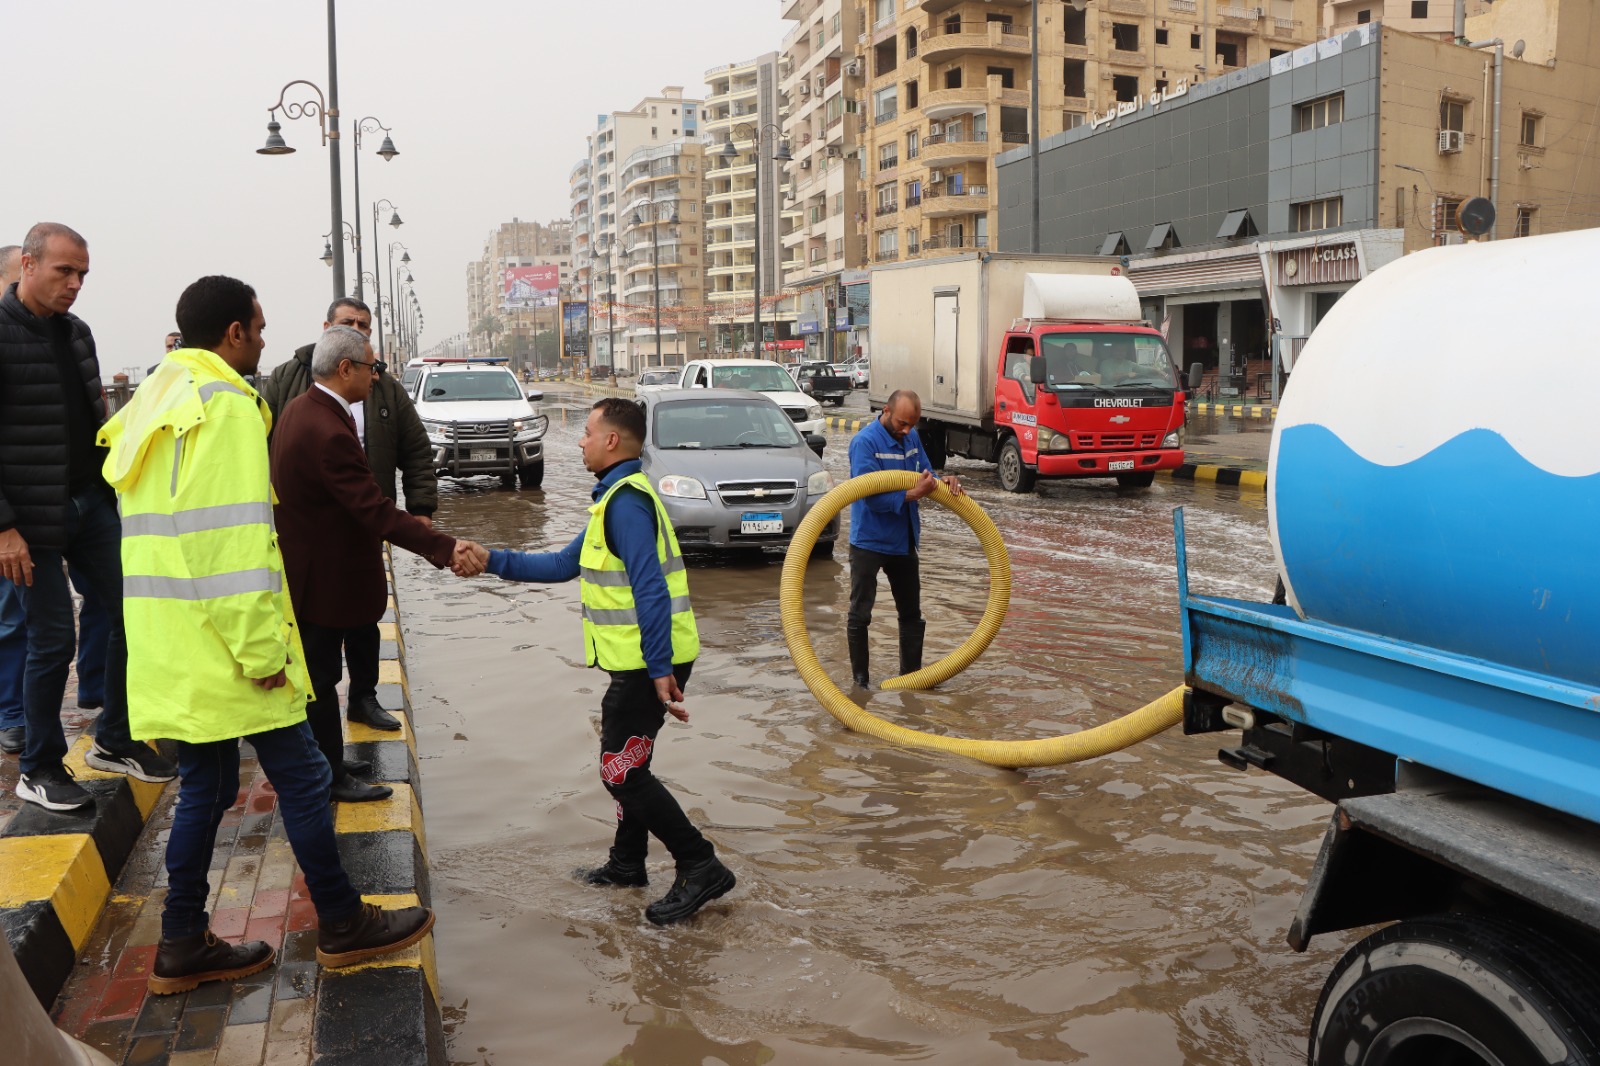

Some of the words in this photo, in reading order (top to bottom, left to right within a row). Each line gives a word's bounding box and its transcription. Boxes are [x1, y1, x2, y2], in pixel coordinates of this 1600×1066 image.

[1150, 78, 1188, 109] نقابة
[1091, 94, 1144, 130] المحامين
[1311, 246, 1357, 263] A-CLASS
[1094, 398, 1143, 408] CHEVROLET
[602, 741, 651, 782] DIESEL
